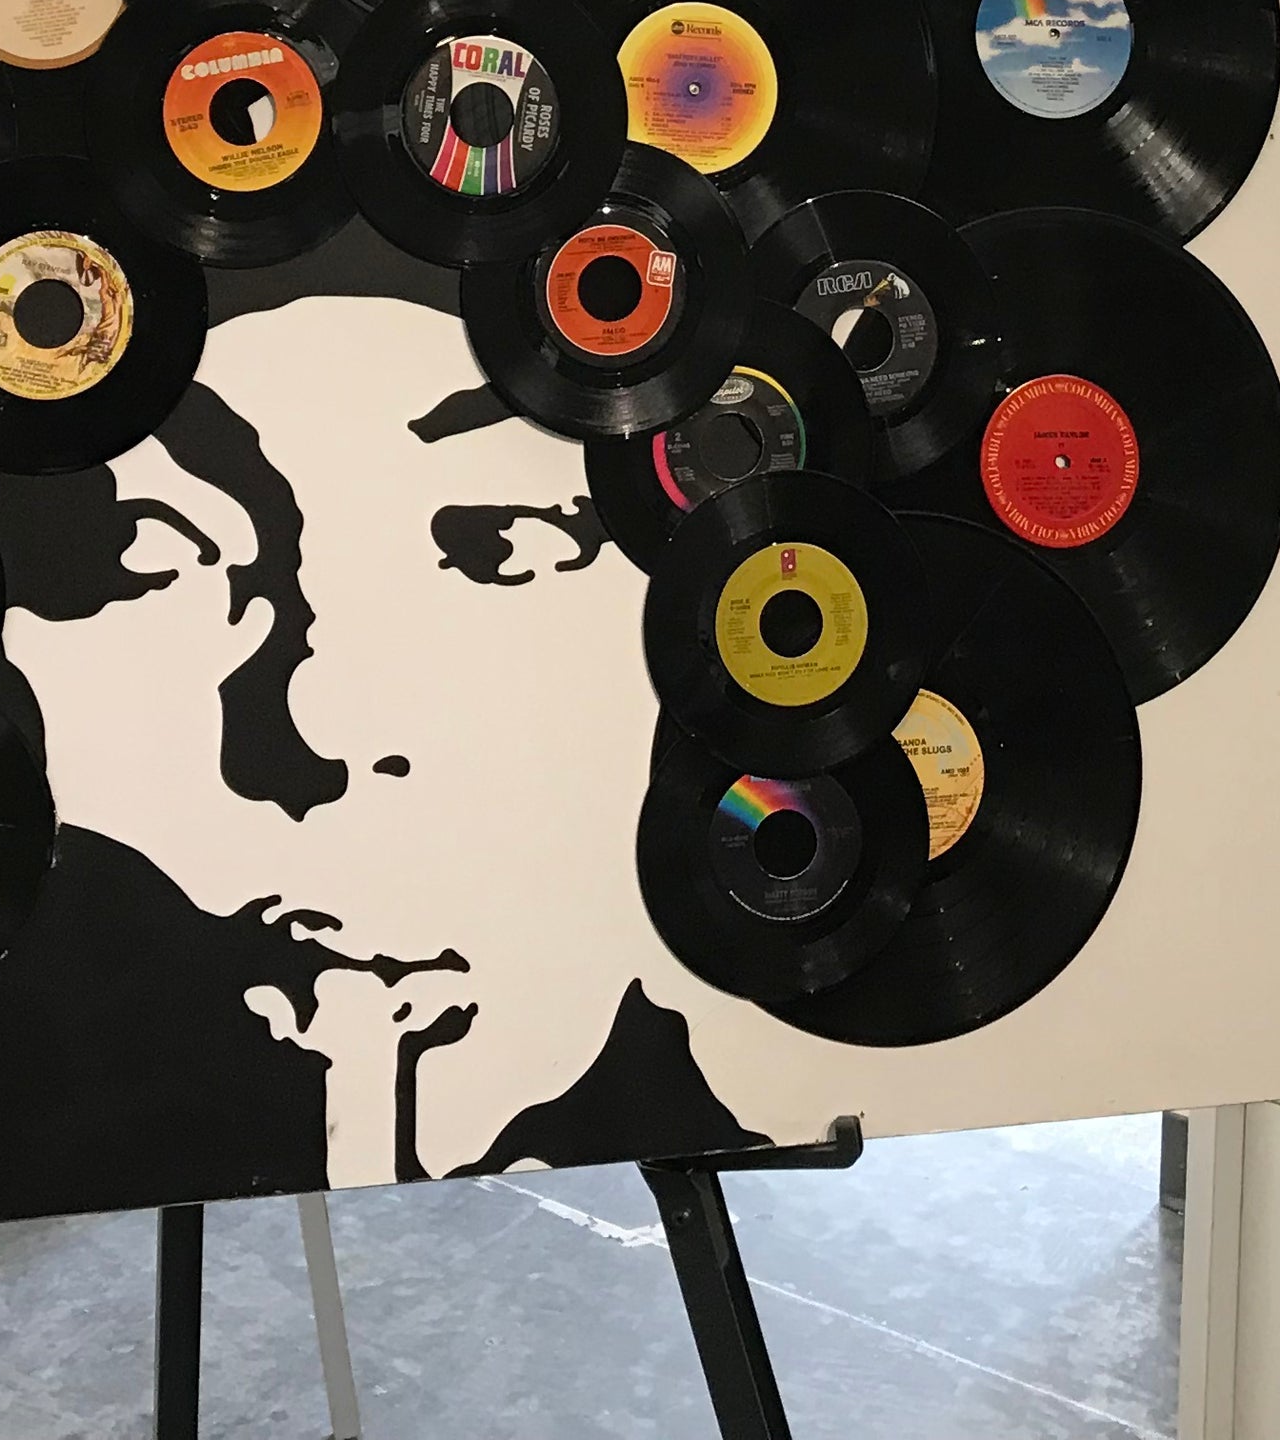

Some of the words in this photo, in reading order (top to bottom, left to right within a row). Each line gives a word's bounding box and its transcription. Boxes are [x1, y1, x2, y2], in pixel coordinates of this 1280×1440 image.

[686, 23, 722, 35] Records
[181, 47, 284, 80] COLUMBIA
[453, 42, 526, 78] CORAL
[426, 63, 440, 94] HAPPY
[435, 97, 446, 113] THE
[528, 87, 541, 103] OF
[422, 94, 436, 121] TIMES
[419, 121, 432, 144] FOUR
[521, 103, 538, 152] PICARDY
[536, 104, 553, 139] ROSES
[221, 150, 249, 162] WILLIE
[250, 143, 284, 156] NELSON
[233, 159, 247, 168] THE
[277, 147, 299, 158] EAGLE
[817, 271, 873, 296] RCA
[922, 746, 952, 755] SLUGS
